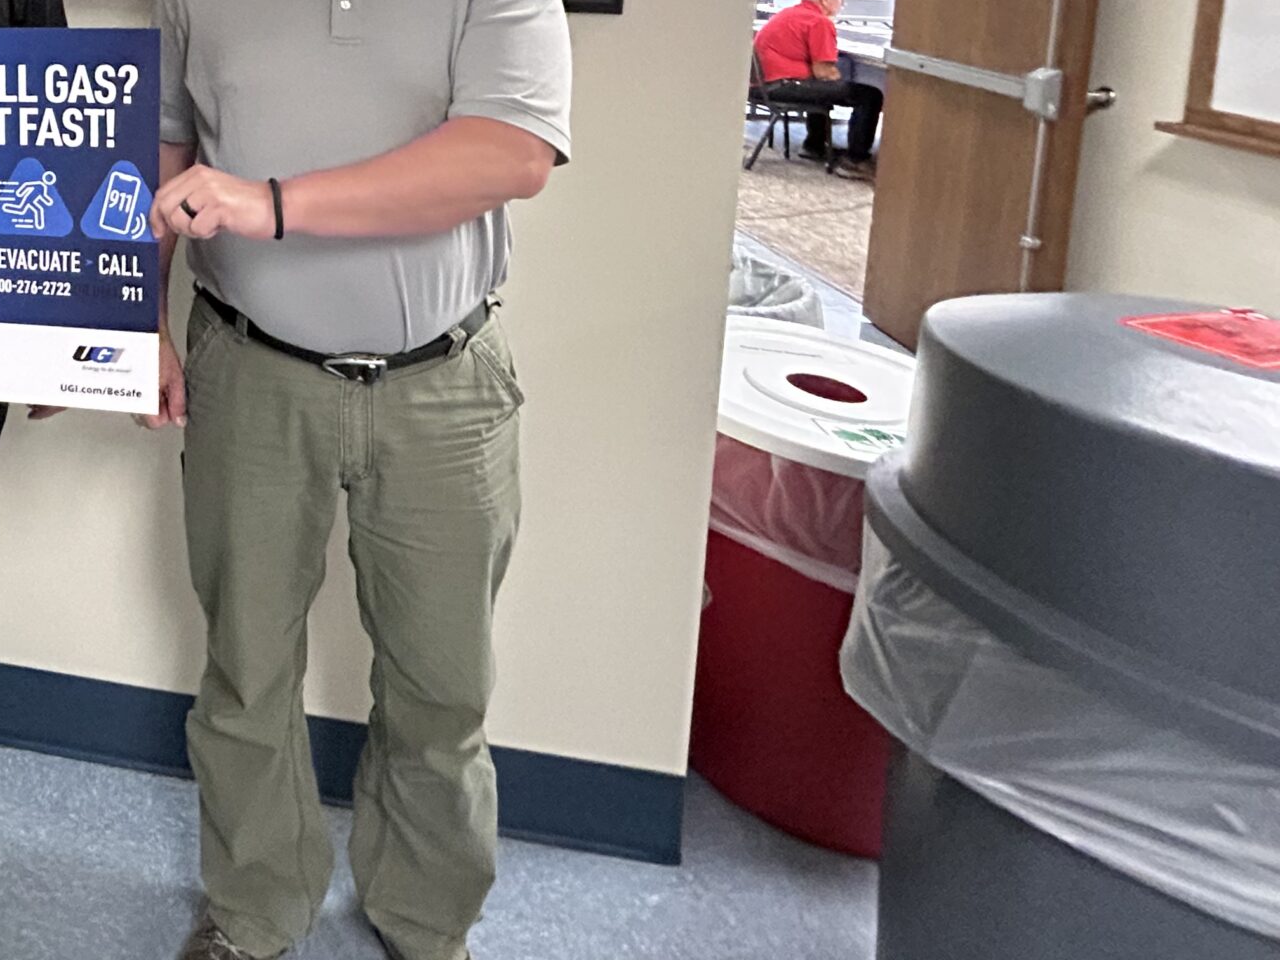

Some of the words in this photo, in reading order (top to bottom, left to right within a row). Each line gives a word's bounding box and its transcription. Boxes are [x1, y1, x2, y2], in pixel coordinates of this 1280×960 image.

[44, 63, 139, 105] GAS?
[19, 107, 116, 148] FAST!
[109, 189, 133, 213] 911
[98, 253, 143, 278] CALL
[121, 285, 143, 302] 911
[72, 345, 125, 364] UGI
[60, 383, 143, 398] UGI.com/BeSafe
